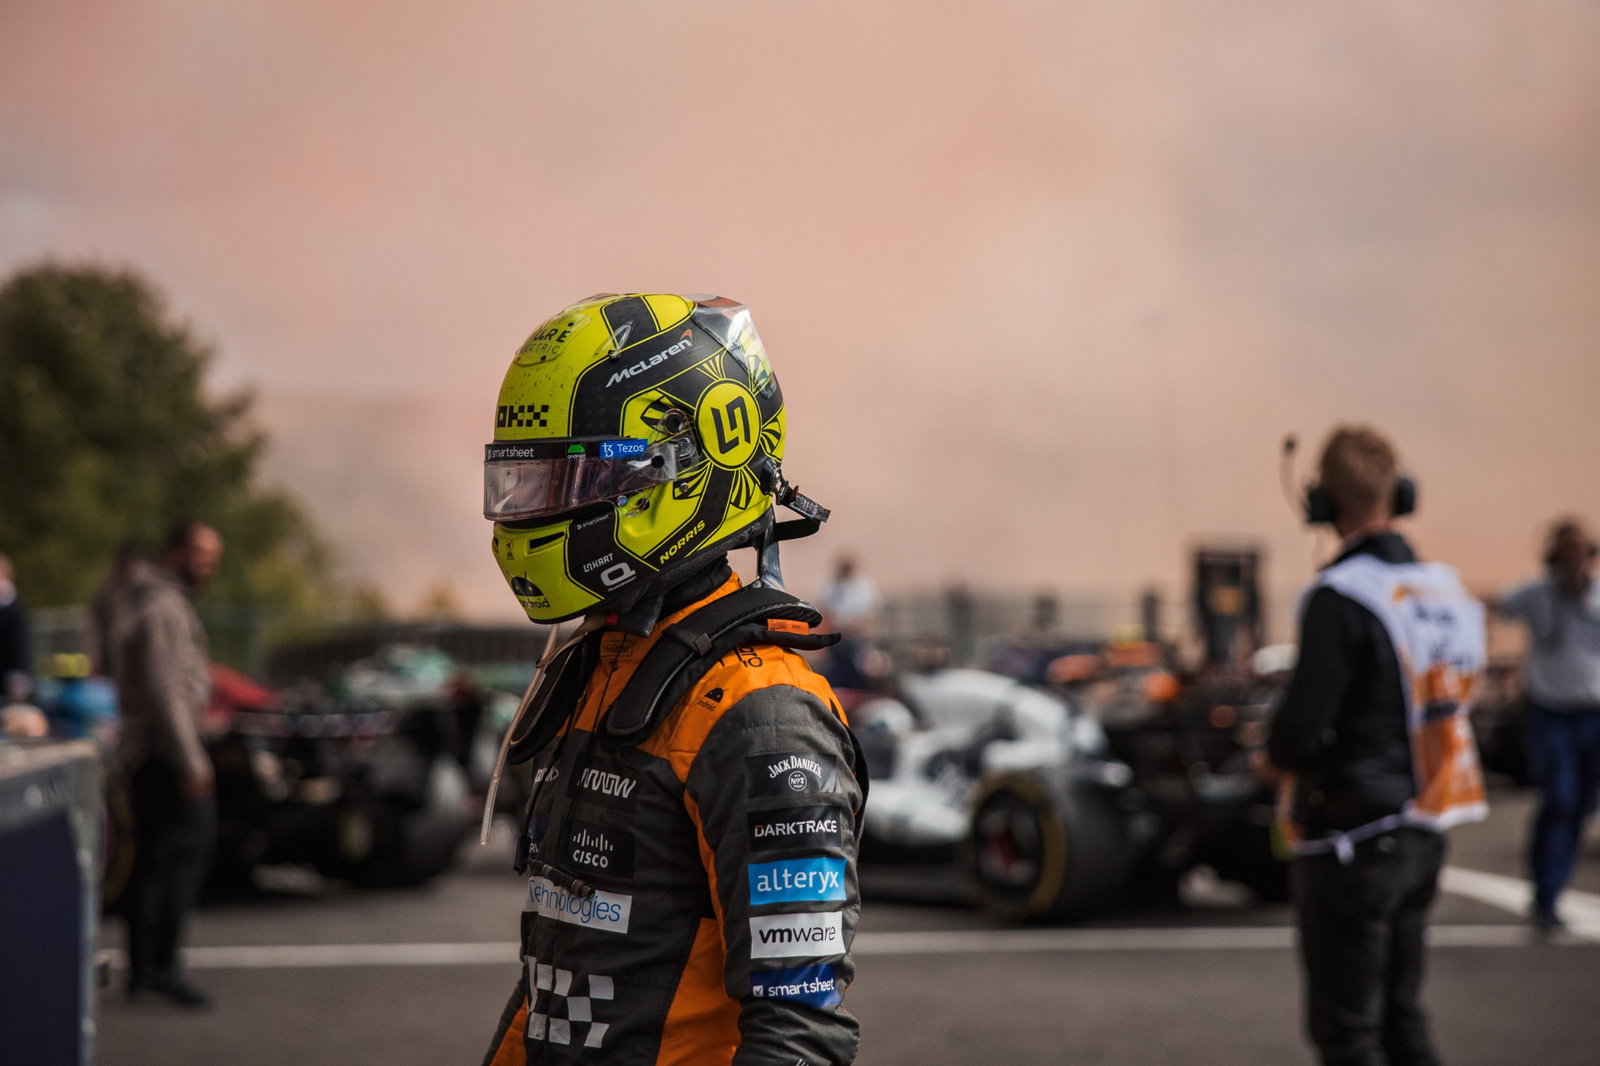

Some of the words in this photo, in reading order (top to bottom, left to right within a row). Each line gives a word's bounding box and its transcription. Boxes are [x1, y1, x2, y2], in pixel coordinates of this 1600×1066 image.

[605, 339, 693, 388] McLaren
[497, 405, 549, 428] OKX
[491, 446, 535, 459] smartsheet
[617, 443, 645, 453] Tezos
[659, 519, 706, 565] NORRIS
[520, 597, 551, 609] ndroid
[754, 820, 837, 837] DARKTRACE
[757, 868, 839, 893] alteryx
[759, 926, 836, 943] vmware
[768, 977, 835, 997] smartsheet
